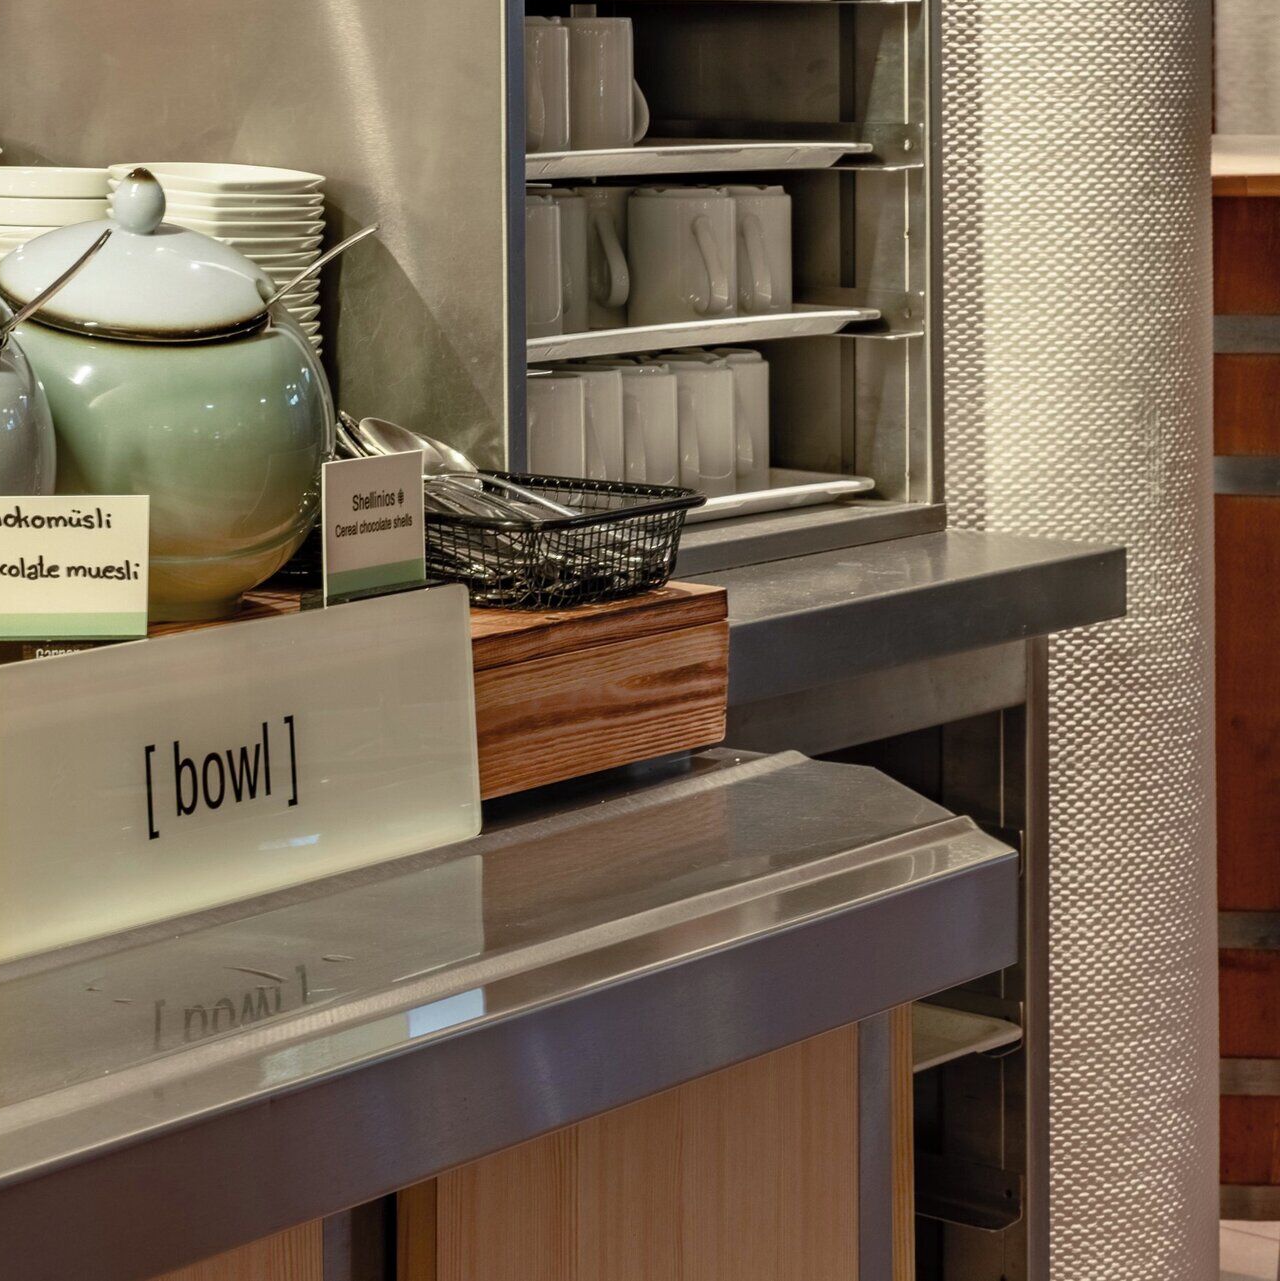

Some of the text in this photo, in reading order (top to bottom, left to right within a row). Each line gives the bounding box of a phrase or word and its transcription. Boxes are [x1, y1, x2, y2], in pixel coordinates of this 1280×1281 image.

[335, 521, 358, 538] Cereal
[359, 517, 392, 535] chocolate
[66, 560, 140, 581] muesli
